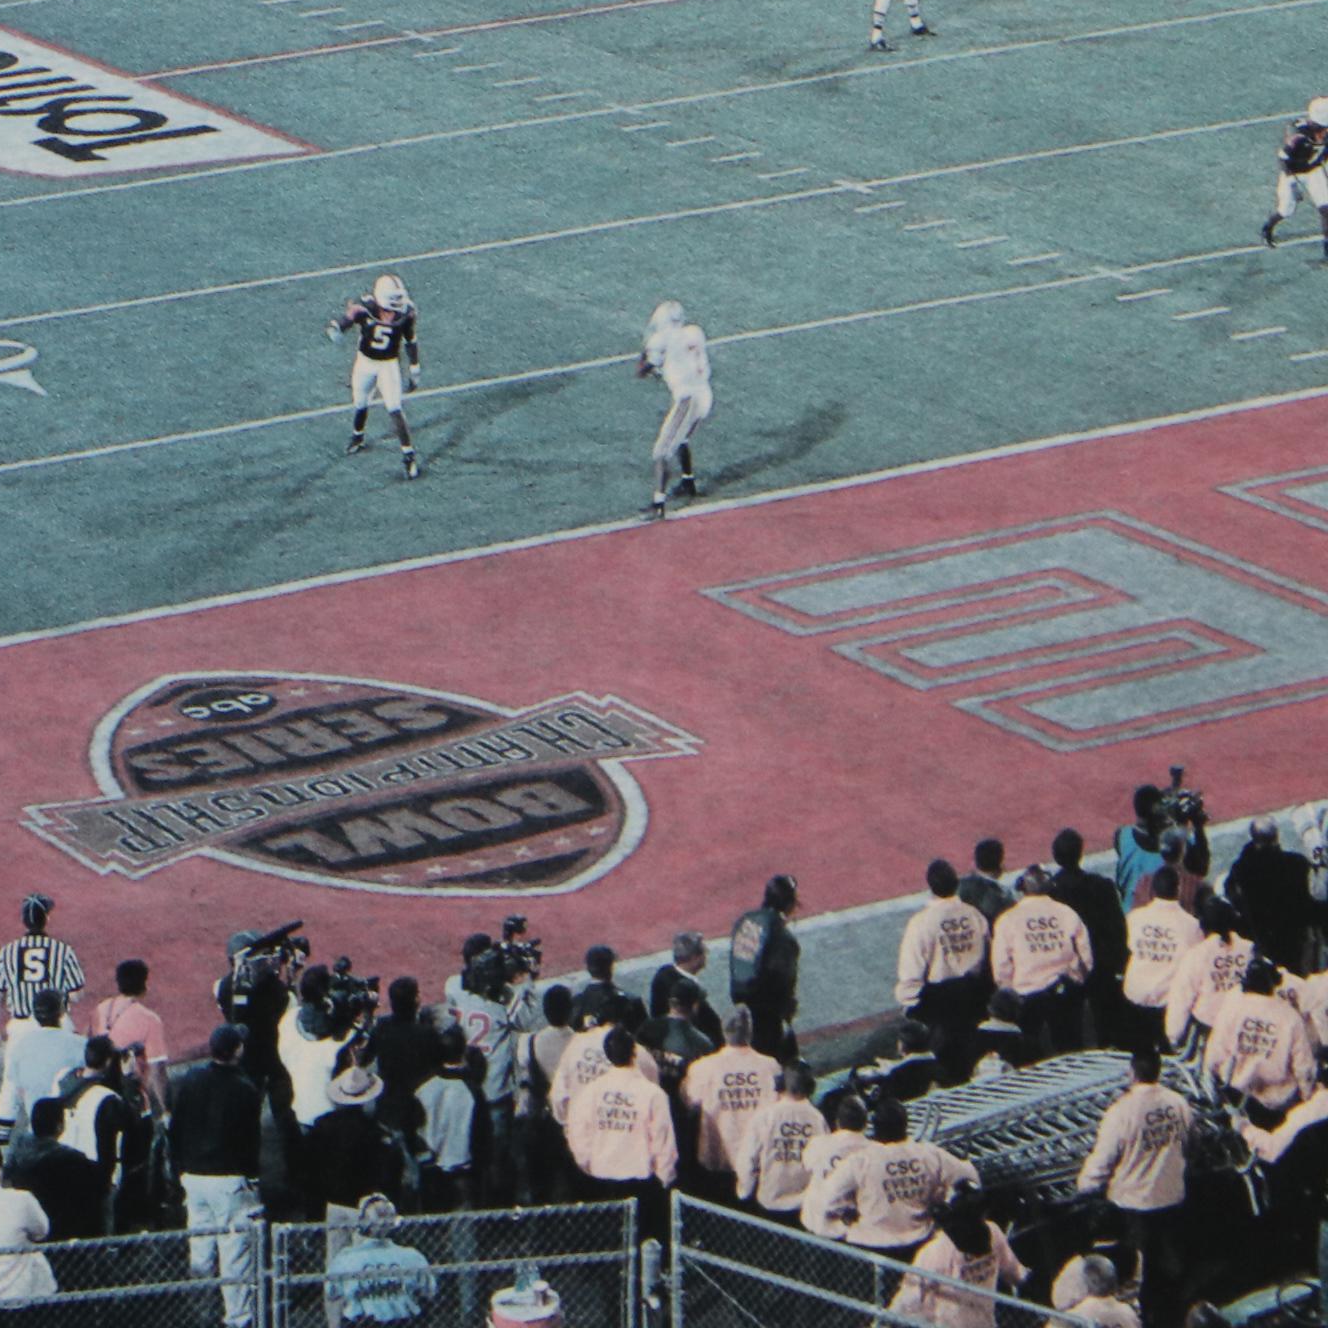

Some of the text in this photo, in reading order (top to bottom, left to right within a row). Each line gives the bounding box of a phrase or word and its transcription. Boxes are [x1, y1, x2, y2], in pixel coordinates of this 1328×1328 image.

[370, 324, 394, 351] 5
[182, 690, 270, 720] abc
[125, 694, 449, 784] SERIES
[104, 706, 638, 858] CHAMPIONSHIP
[265, 780, 571, 864] BOWL
[940, 917, 970, 933] CSC
[1026, 916, 1060, 931] CSC
[1142, 925, 1175, 940] CSC
[23, 947, 46, 983] S
[1213, 954, 1246, 970] CSC
[1243, 1017, 1277, 1035] CSC
[723, 1072, 759, 1087] CSC
[603, 1091, 635, 1107] CSC
[718, 1087, 762, 1102] EVENT
[1146, 1105, 1177, 1126] CSC
[781, 1121, 813, 1138] CSC
[885, 1159, 921, 1175] CSC
